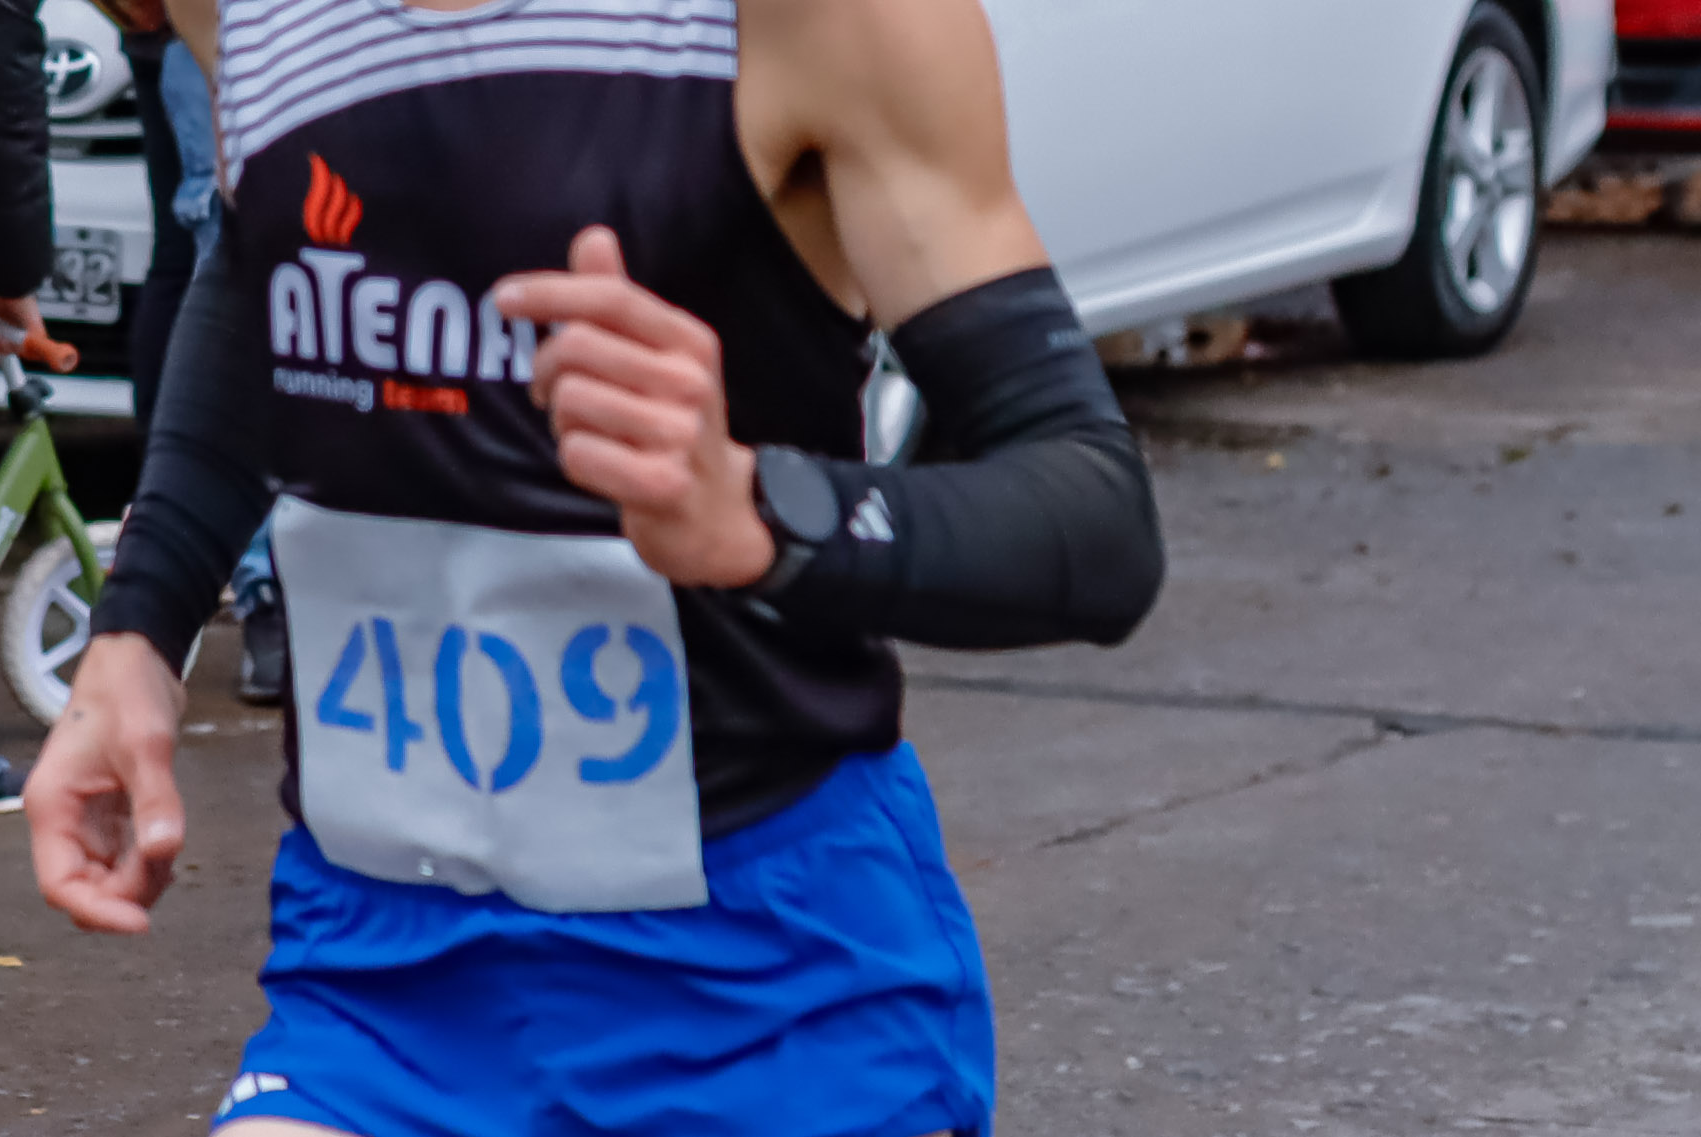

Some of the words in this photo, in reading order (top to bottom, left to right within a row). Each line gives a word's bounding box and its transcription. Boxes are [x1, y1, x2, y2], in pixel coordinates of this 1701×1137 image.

[269, 247, 566, 381] ATENA
[273, 367, 374, 413] running
[316, 615, 680, 793] 409
